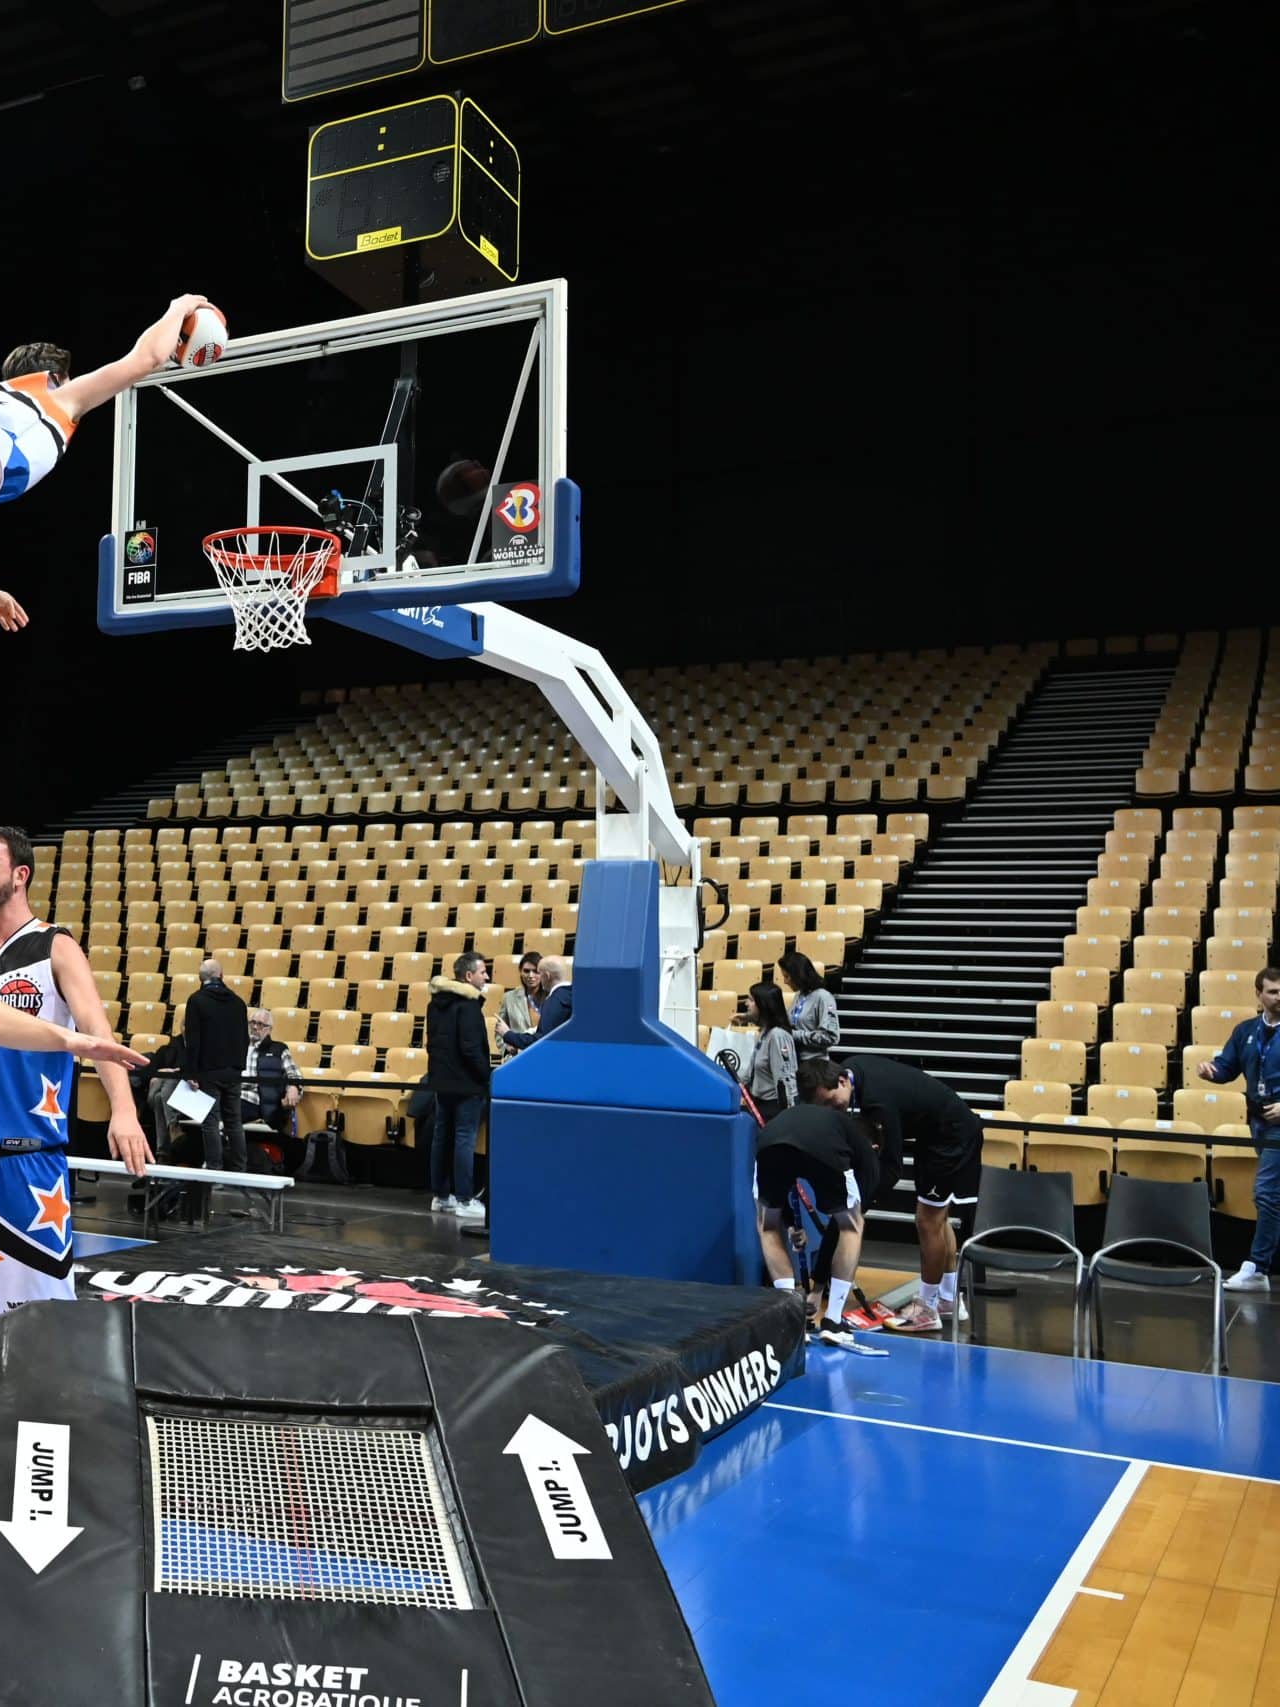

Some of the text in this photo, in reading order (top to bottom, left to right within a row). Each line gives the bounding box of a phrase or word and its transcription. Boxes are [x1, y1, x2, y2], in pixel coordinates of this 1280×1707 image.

[360, 231, 399, 247] Bodet
[493, 550, 525, 561] WORLD
[526, 547, 544, 557] CUP
[128, 571, 151, 585] FIBA
[682, 1343, 782, 1433] DUNKERS
[31, 1441, 55, 1502] JUMP
[543, 1479, 589, 1543] JUMP
[218, 1658, 370, 1691] BASKET
